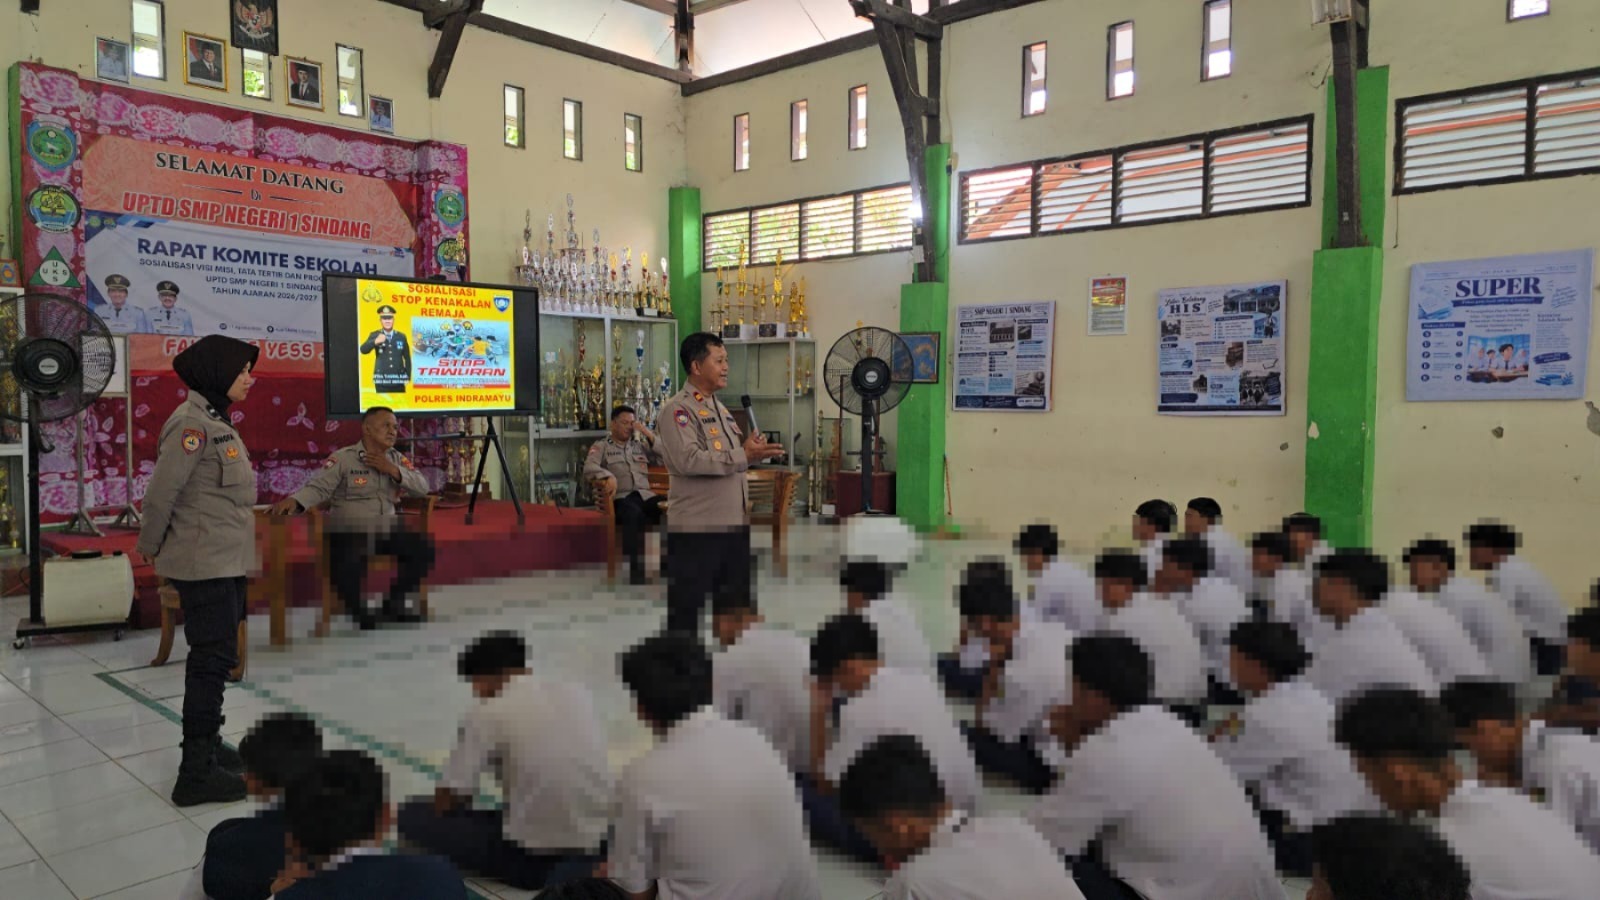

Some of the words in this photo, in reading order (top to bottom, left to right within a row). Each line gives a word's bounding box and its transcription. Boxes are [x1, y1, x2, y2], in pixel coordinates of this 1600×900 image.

[156, 152, 255, 181] SELAMAT
[262, 168, 344, 194] DATANG
[123, 192, 176, 216] UPTD
[179, 201, 224, 221] SMP
[225, 205, 286, 229] NEGERI
[290, 213, 299, 231] 1
[301, 217, 371, 240] SINDANG
[138, 238, 207, 260] RAPAT
[213, 246, 288, 268] KOMITE
[294, 255, 377, 275] SEKOLAH
[139, 258, 194, 270] SOSIALISASI
[197, 264, 213, 272] VISI
[238, 268, 256, 276] TATA
[258, 270, 283, 279] TERTIB
[285, 272, 301, 280] DAN
[206, 275, 228, 284] UPTD
[250, 279, 278, 287] NEGERI
[286, 283, 322, 292] SINDANG
[408, 284, 476, 297] SOSIALISASI
[1456, 277, 1542, 298] SUPER
[212, 286, 241, 296] TAHUN
[242, 289, 275, 299] AJARAN
[392, 295, 421, 304] STOP
[425, 296, 491, 308] KENAKALAN
[421, 308, 465, 318] REMAJA
[267, 342, 313, 358] YESS
[438, 358, 486, 366] STOP
[418, 367, 506, 376] TAWURAN
[415, 394, 453, 403] POLRES
[456, 394, 511, 402] INDRAMAYU
